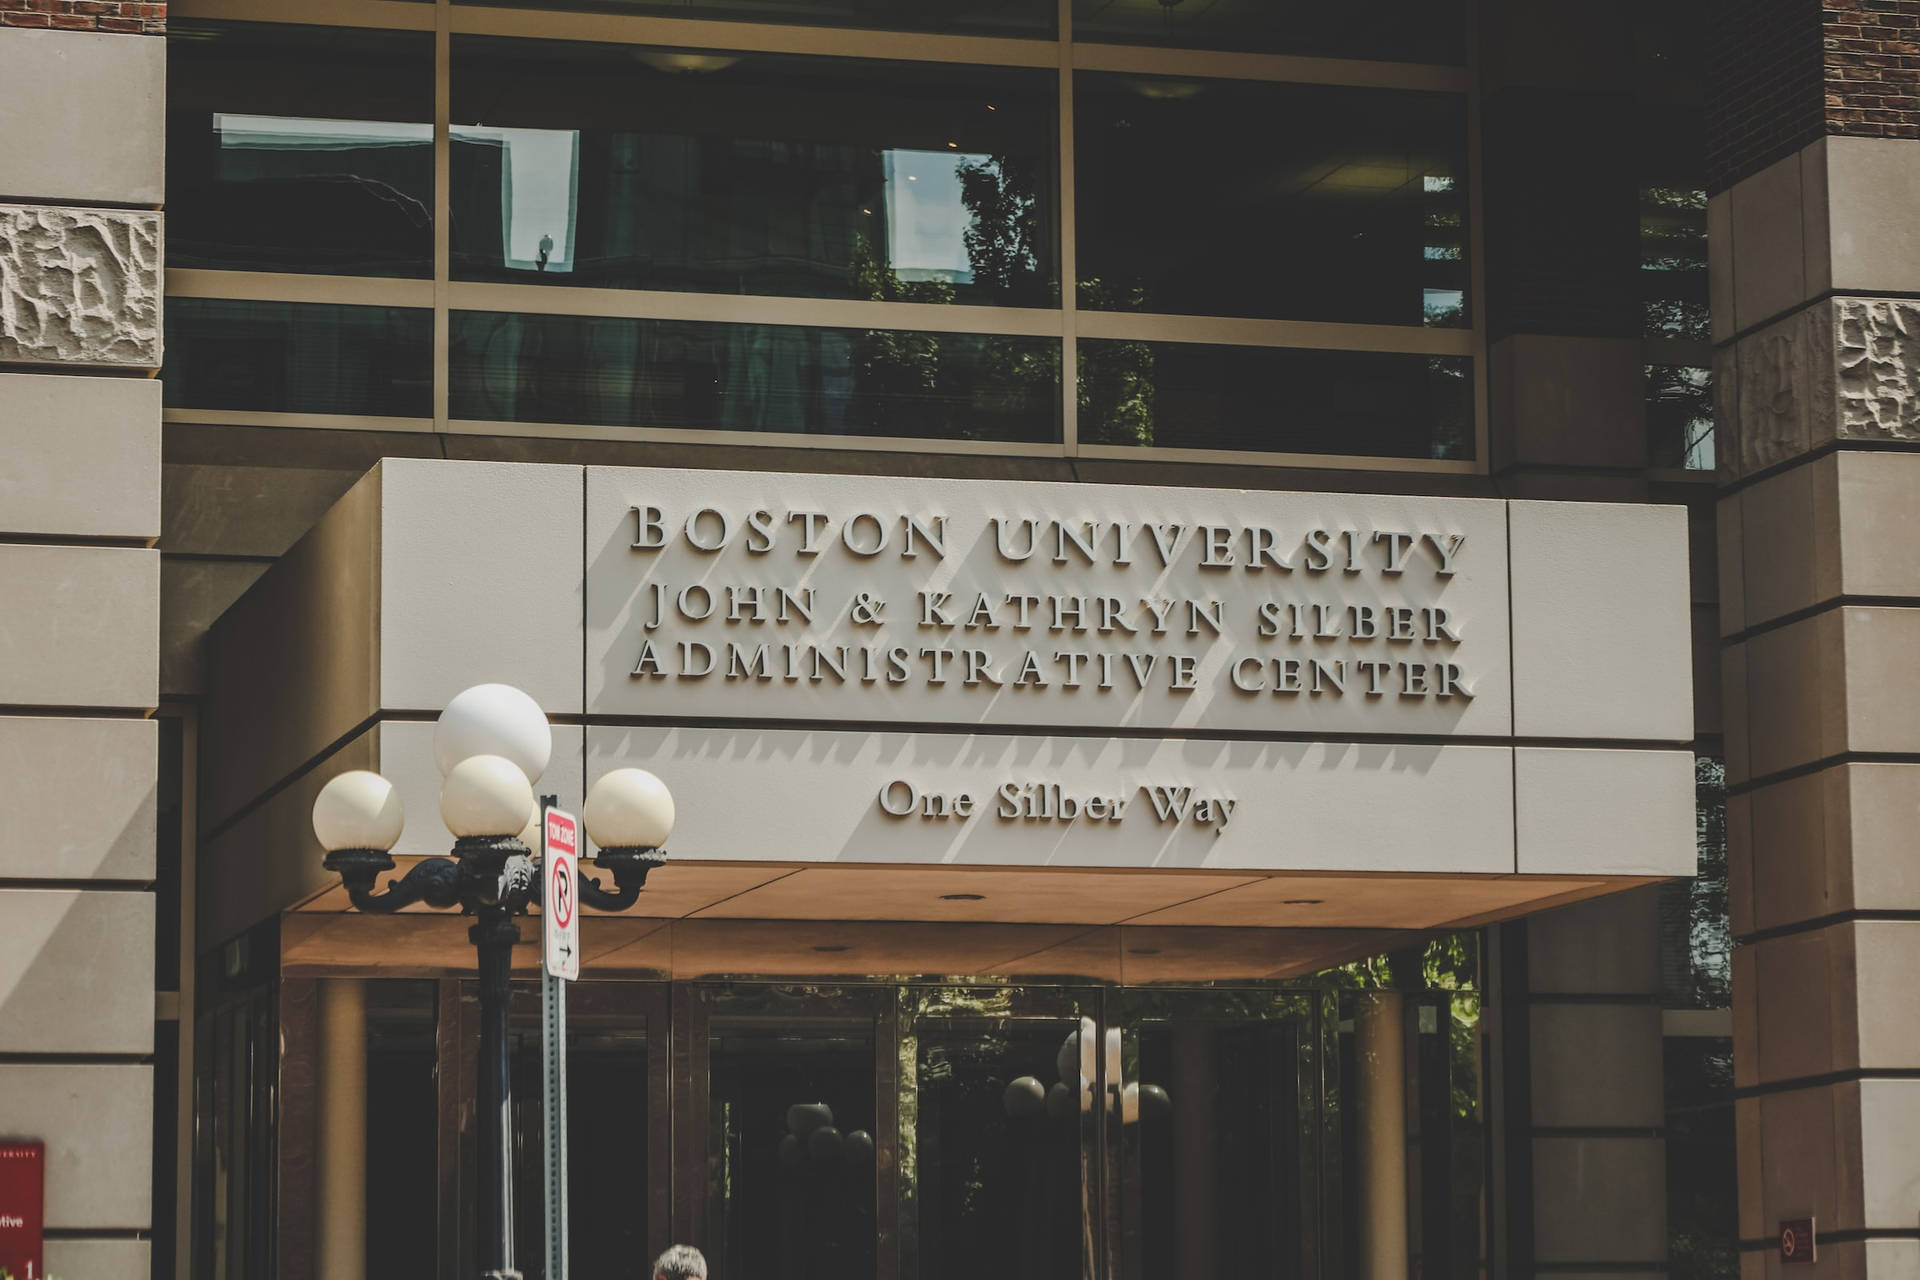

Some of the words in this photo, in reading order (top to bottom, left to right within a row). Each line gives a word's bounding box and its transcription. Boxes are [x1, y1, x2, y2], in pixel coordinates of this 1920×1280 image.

[630, 505, 950, 560] BOSTON
[990, 516, 1465, 579] UNIVERSITY
[644, 583, 817, 631] JOHN
[851, 591, 886, 625] &
[916, 591, 1225, 635] KATHRYN
[1257, 601, 1462, 644] SILBER
[630, 639, 1200, 690] ADMINISTRATIVE
[1231, 656, 1476, 700] CENTER
[549, 822, 560, 841] TOW
[560, 827, 575, 847] ZONE
[878, 780, 976, 820] One
[997, 781, 1127, 823] Silber
[1139, 785, 1239, 836] Way
